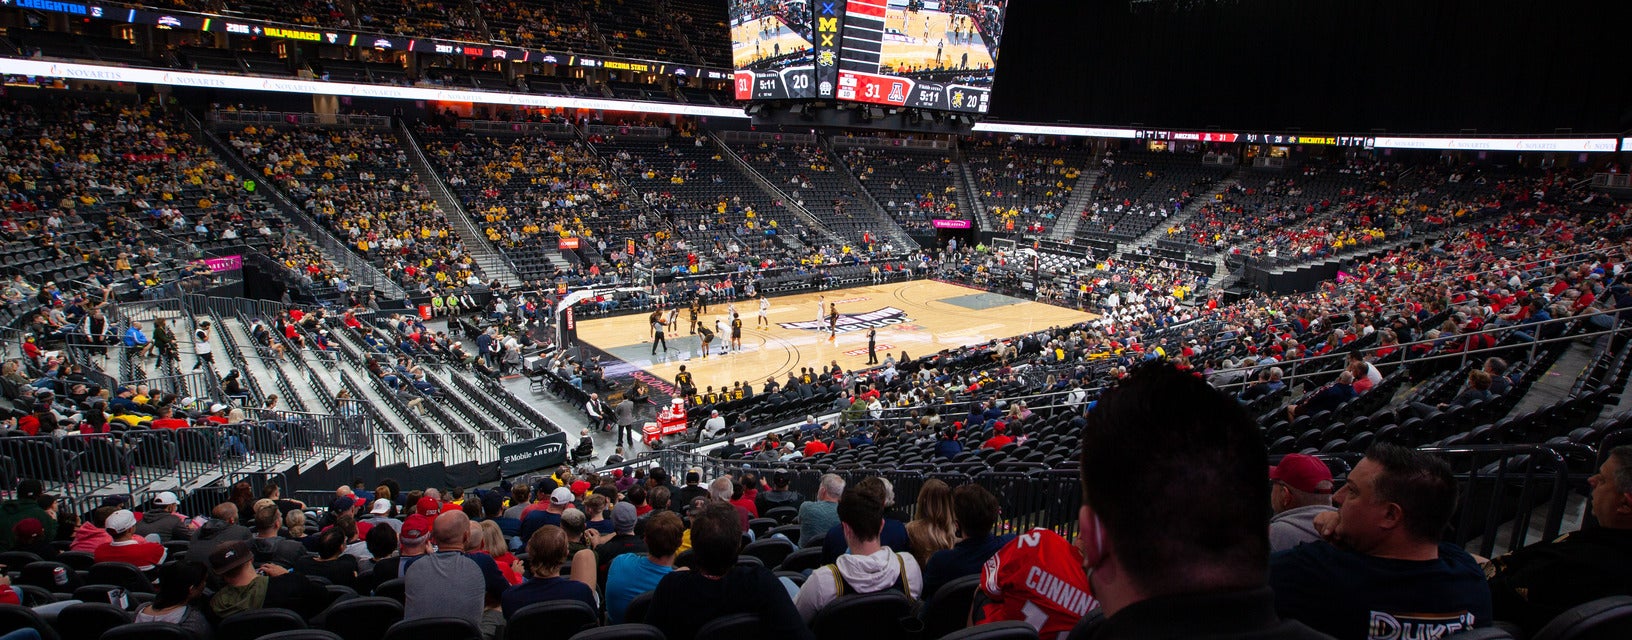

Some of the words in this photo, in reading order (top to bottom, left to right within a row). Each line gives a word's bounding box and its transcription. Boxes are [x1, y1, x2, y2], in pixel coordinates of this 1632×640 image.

[16, 0, 86, 14] CREIGHTON
[818, 17, 837, 32] M
[263, 27, 322, 41] VALPARAISO
[603, 61, 630, 70] ARIZONA
[630, 64, 648, 72] STATE
[67, 68, 122, 79] NOVARTIS
[176, 76, 226, 86] NOVARTIS
[739, 78, 748, 92] 31
[760, 79, 776, 90] 5:11
[792, 74, 809, 89] 20
[274, 83, 317, 92] NOVARTIS
[362, 88, 401, 97] NOVARTIS
[864, 83, 881, 99] 31
[919, 90, 940, 103] 5:11
[966, 94, 978, 108] 20
[1326, 137, 1336, 145] ST.
[533, 446, 558, 457] ARENA
